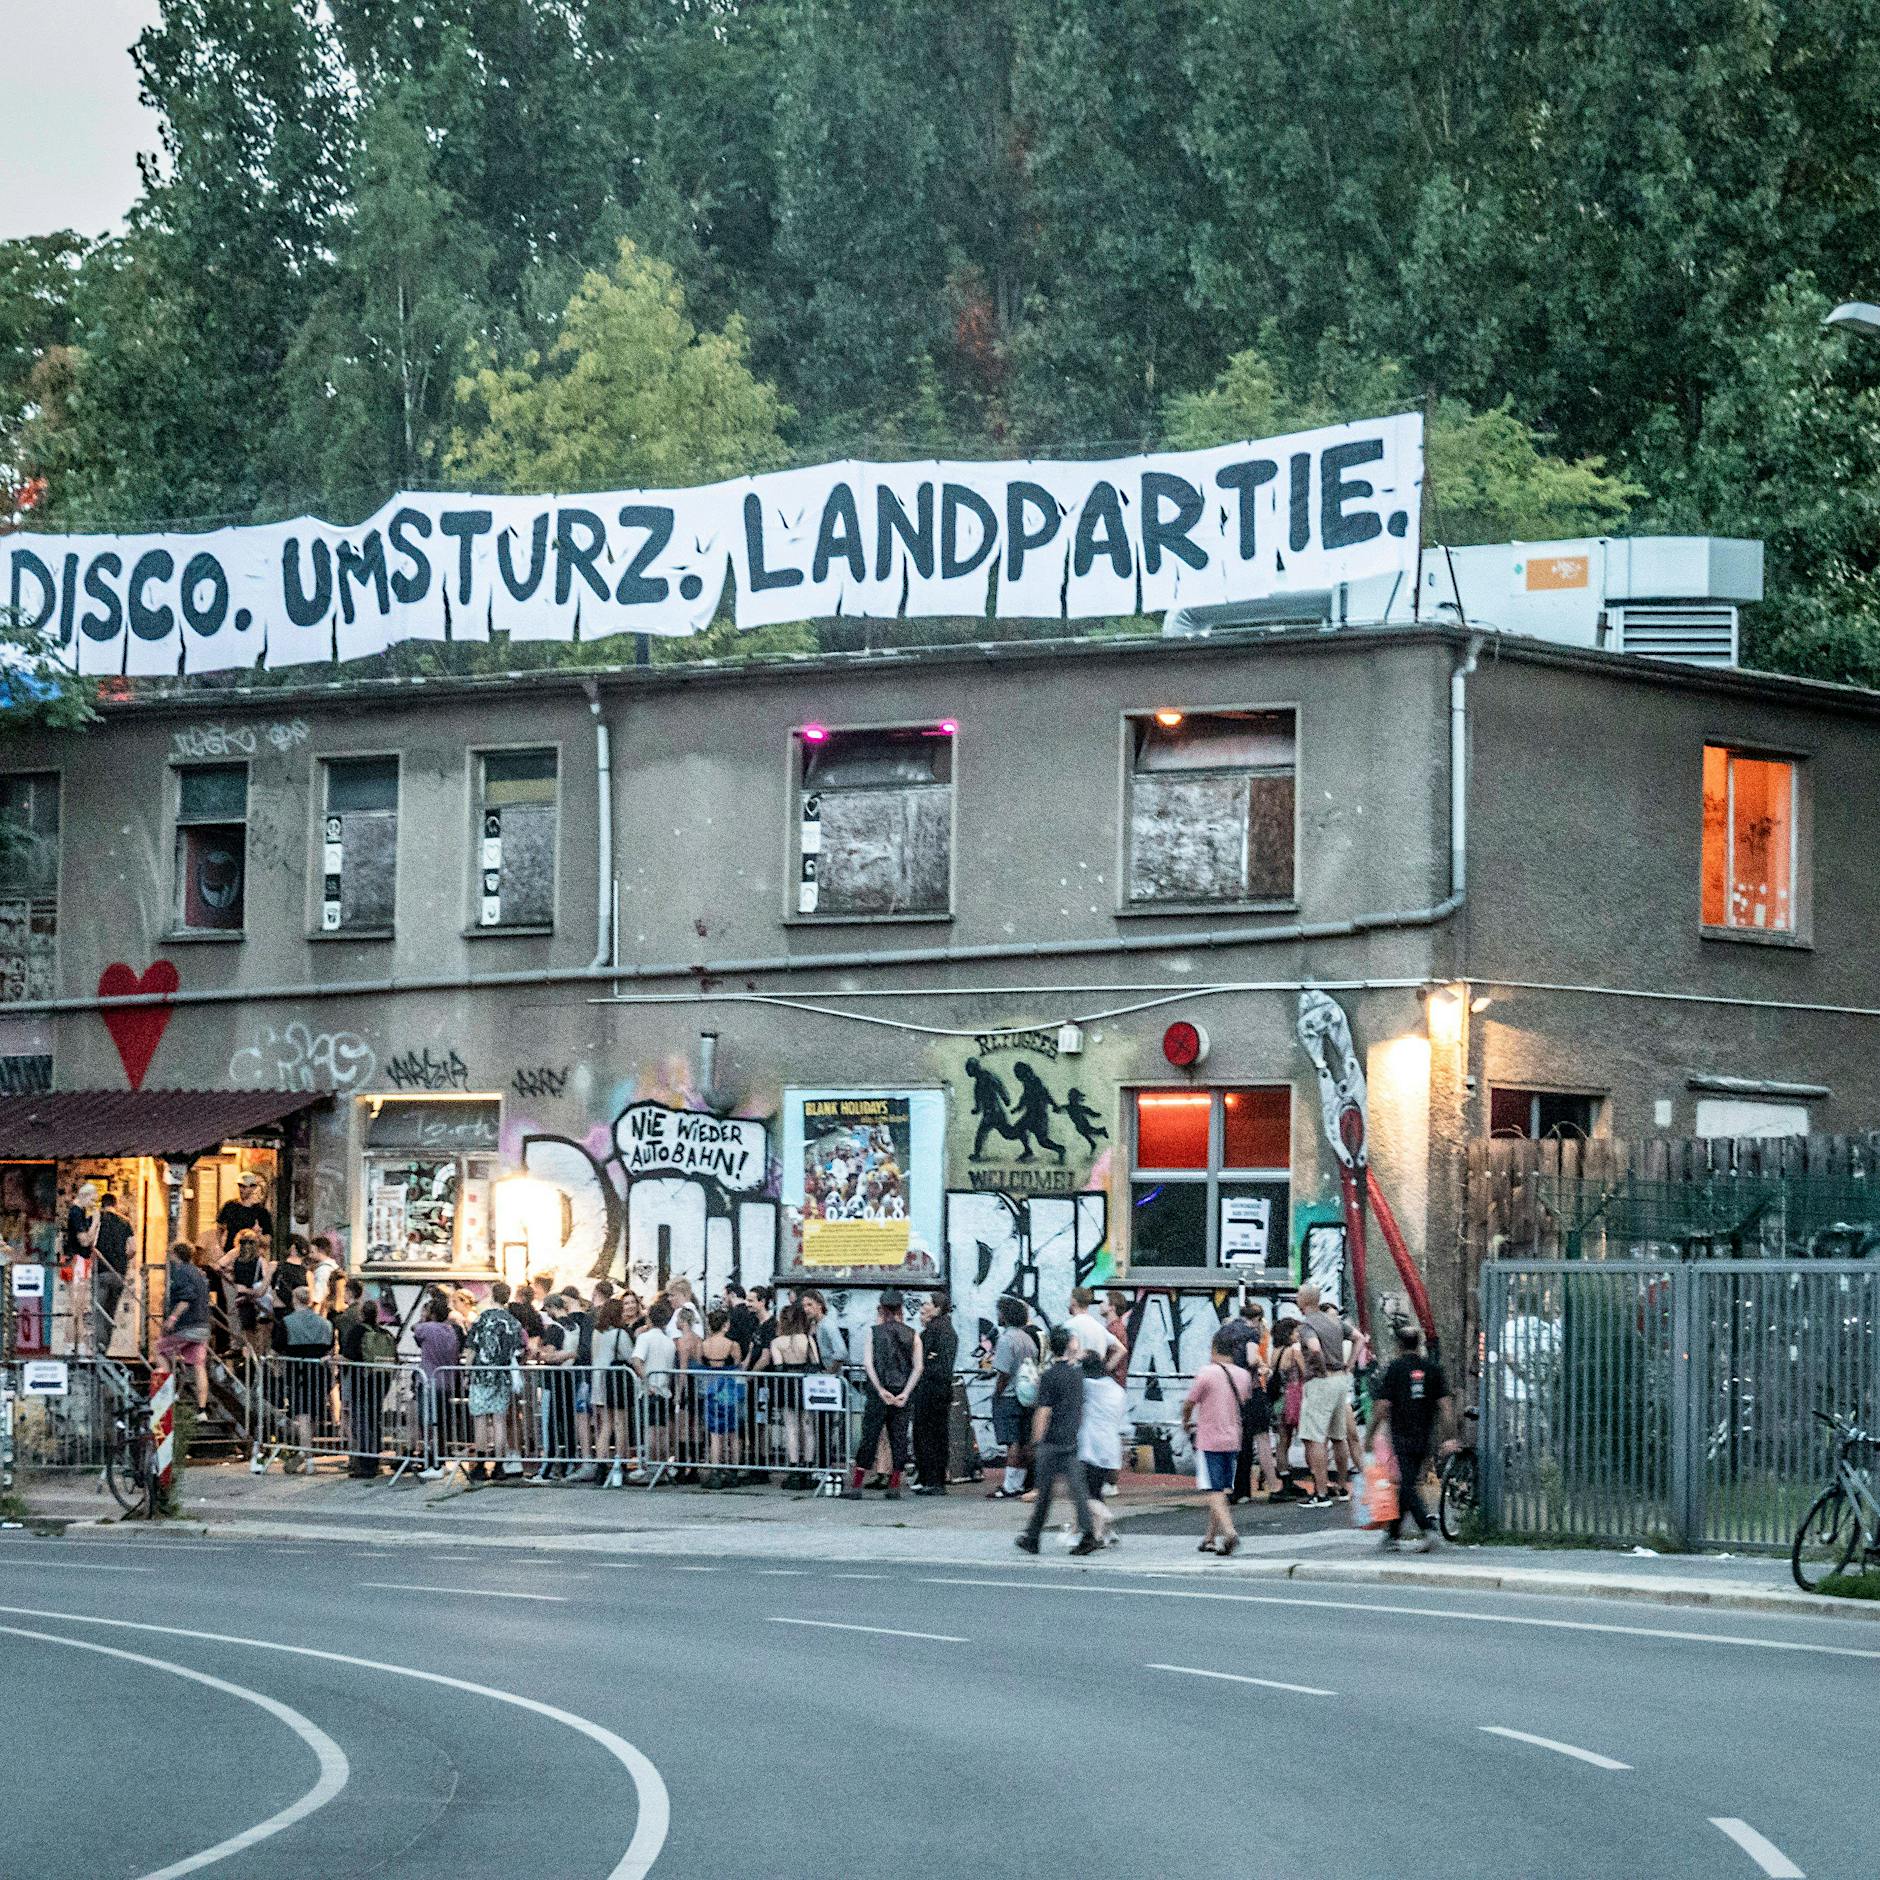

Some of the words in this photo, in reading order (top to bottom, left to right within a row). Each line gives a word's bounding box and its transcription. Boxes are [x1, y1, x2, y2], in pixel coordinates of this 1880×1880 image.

[11, 548, 254, 646] DISCO.
[281, 505, 704, 627] UMSTURZ.
[743, 438, 1409, 593] LANDPARTIE.
[975, 1027, 1060, 1061] REFUGEES
[804, 1101, 838, 1116] BLANK
[840, 1100, 889, 1115] HOLIDAYS
[630, 1139, 750, 1180] AUTOBAHN!
[967, 1169, 1075, 1191] WELCOME!
